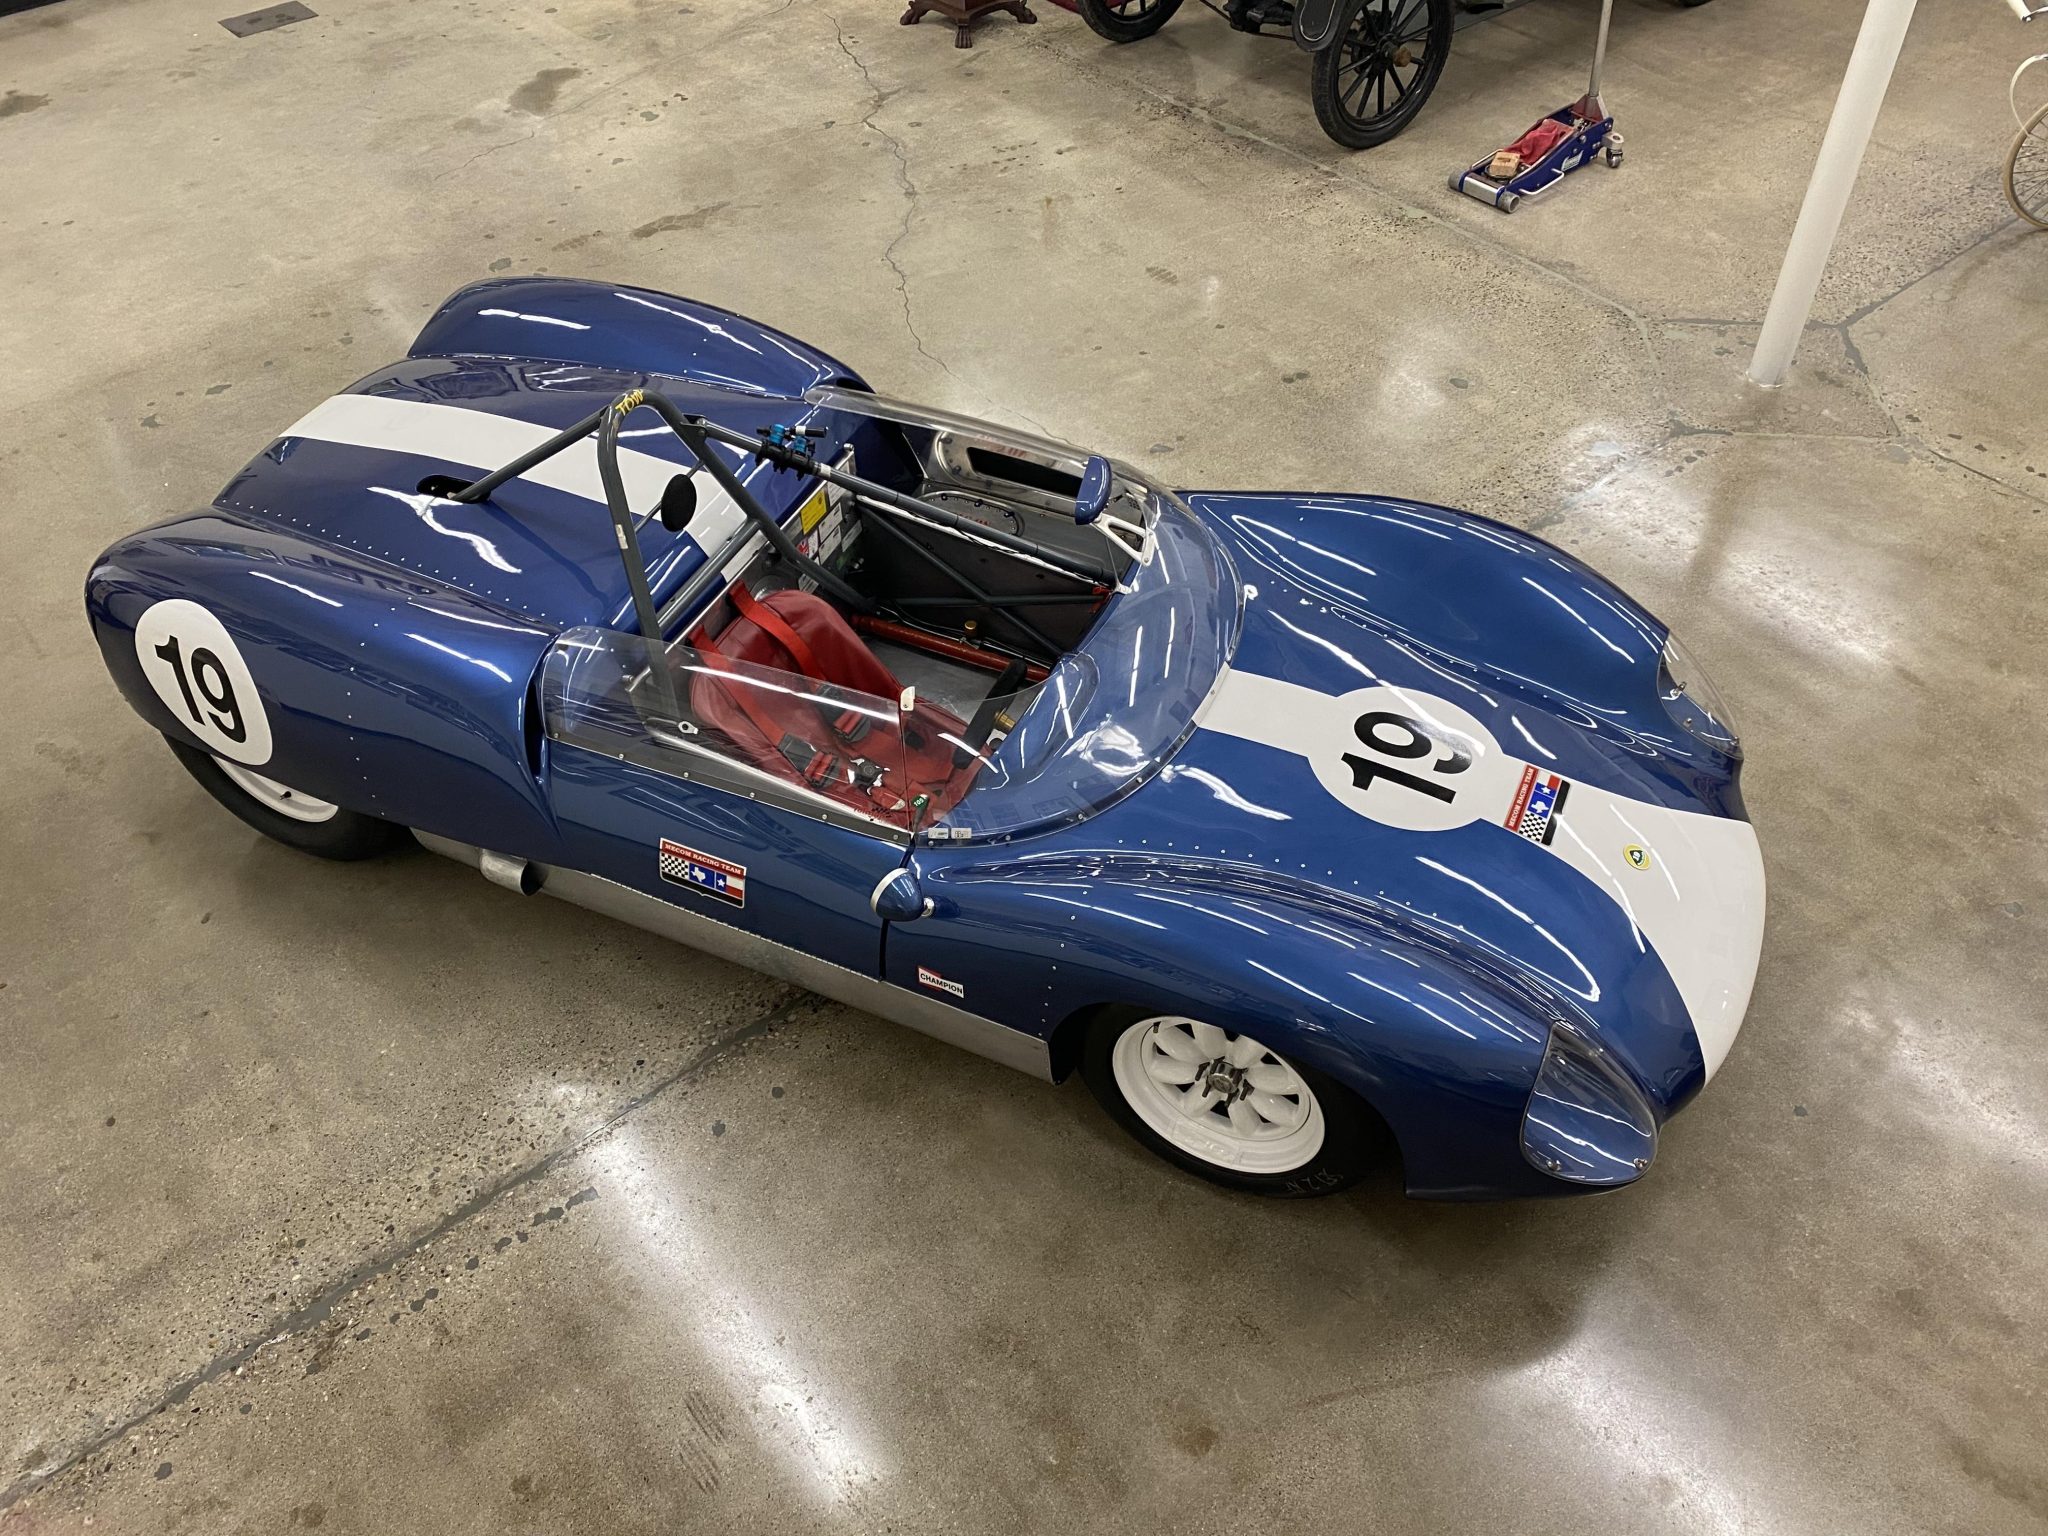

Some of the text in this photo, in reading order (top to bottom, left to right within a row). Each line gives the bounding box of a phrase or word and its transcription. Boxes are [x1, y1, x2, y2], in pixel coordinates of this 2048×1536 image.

[614, 388, 645, 416] TOW
[154, 634, 247, 744] 19
[1340, 711, 1473, 805] 19
[1508, 767, 1534, 828] MECOM RACING TEAM
[664, 843, 741, 875] MECOM RACING TEAM
[920, 973, 963, 994] CHAMPION
